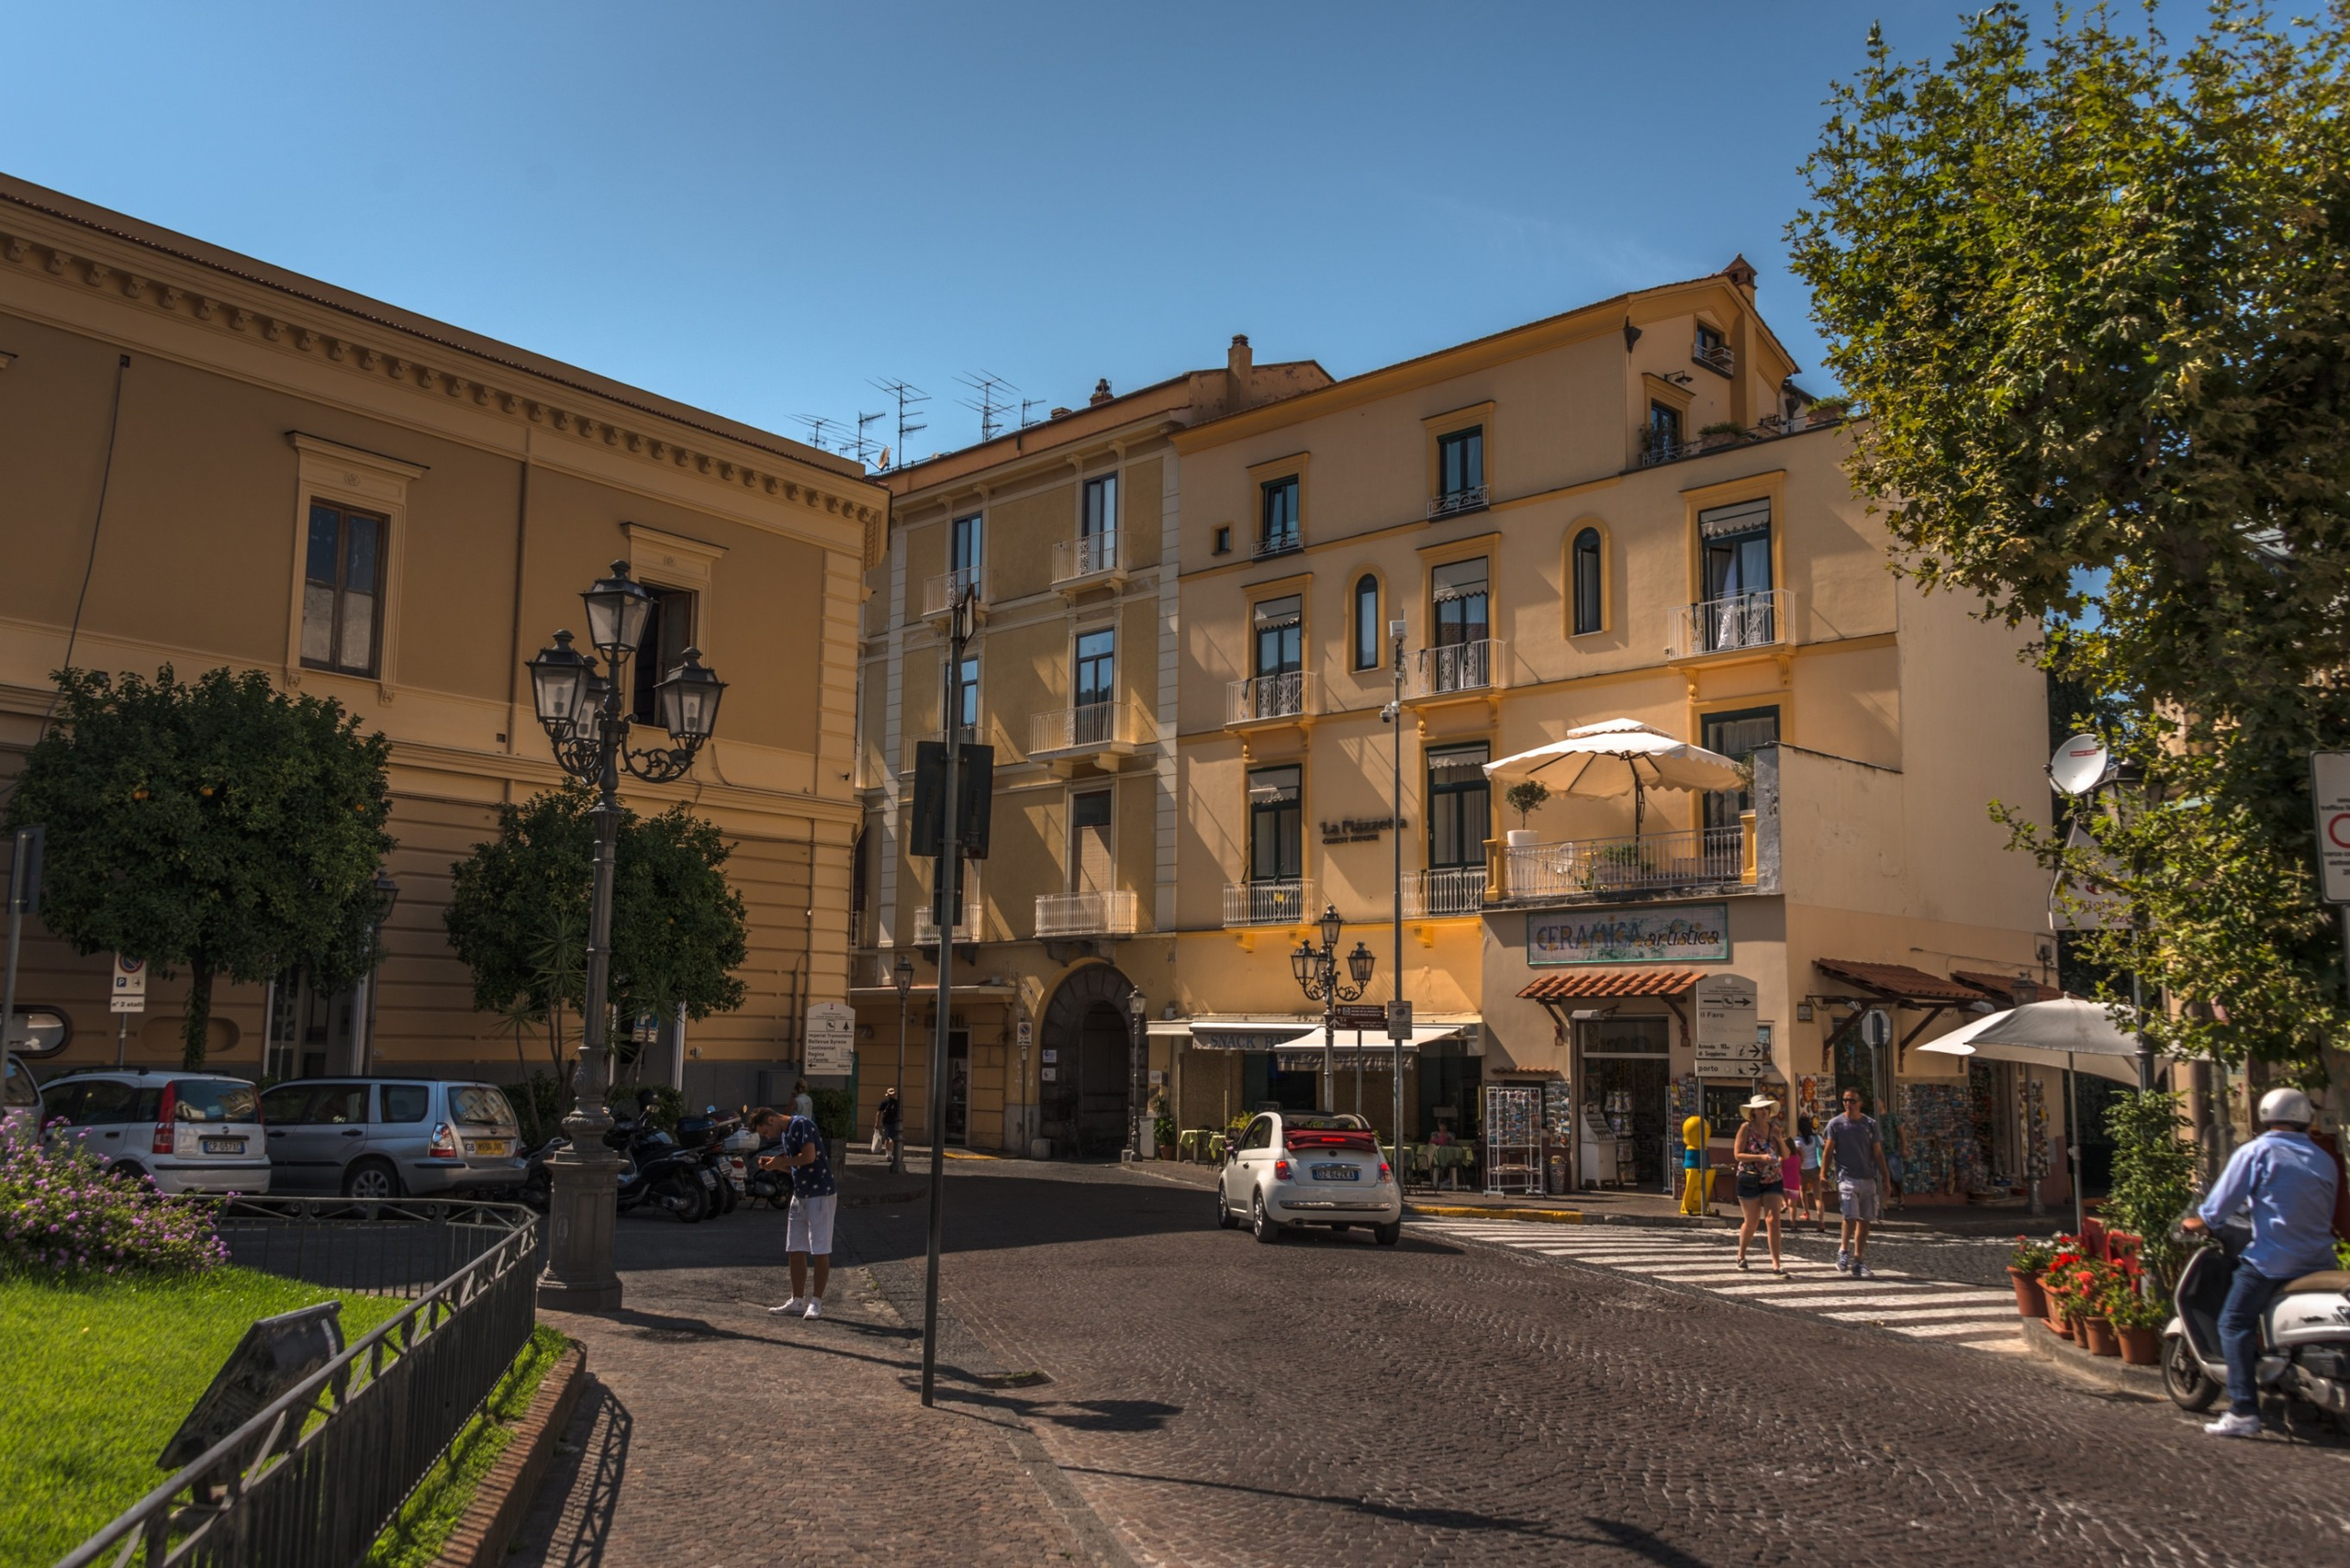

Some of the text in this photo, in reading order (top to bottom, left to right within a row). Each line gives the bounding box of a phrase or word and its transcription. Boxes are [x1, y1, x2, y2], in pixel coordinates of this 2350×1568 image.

[1536, 920, 1719, 952] CERAMICA artistica
[1210, 1033, 1257, 1049] SNACK
